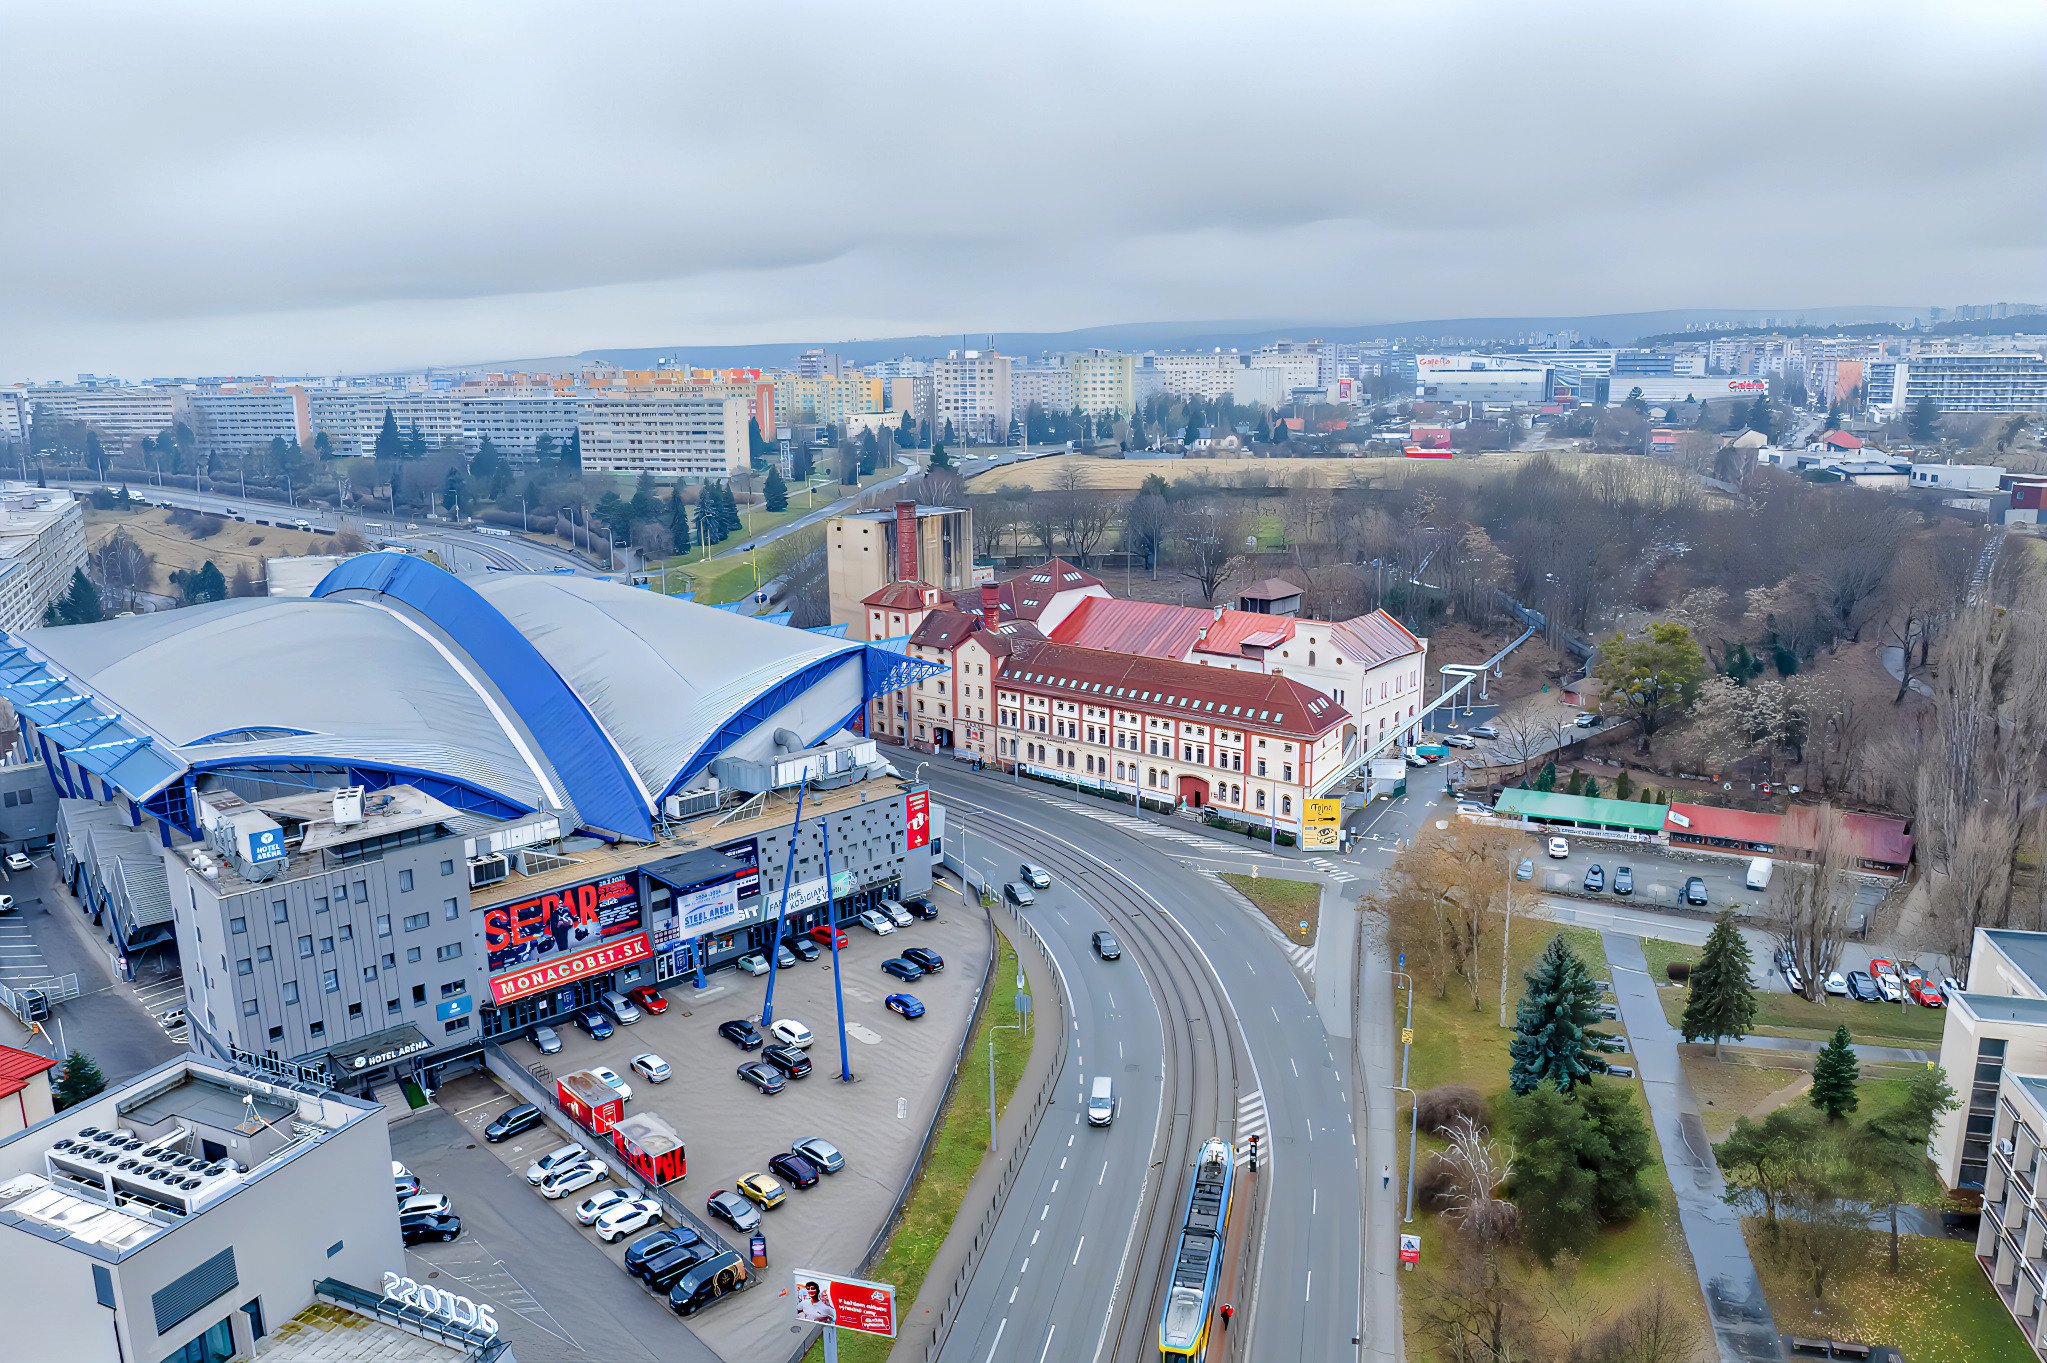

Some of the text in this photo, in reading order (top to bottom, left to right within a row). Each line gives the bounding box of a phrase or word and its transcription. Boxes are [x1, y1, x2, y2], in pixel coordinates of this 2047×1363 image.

[256, 843, 281, 854] HOTEL
[484, 884, 600, 953] SEPAR
[684, 903, 735, 926] STEEL ARENA
[500, 940, 645, 995] MONACOBET.SK
[368, 1050, 397, 1066] HOTEL
